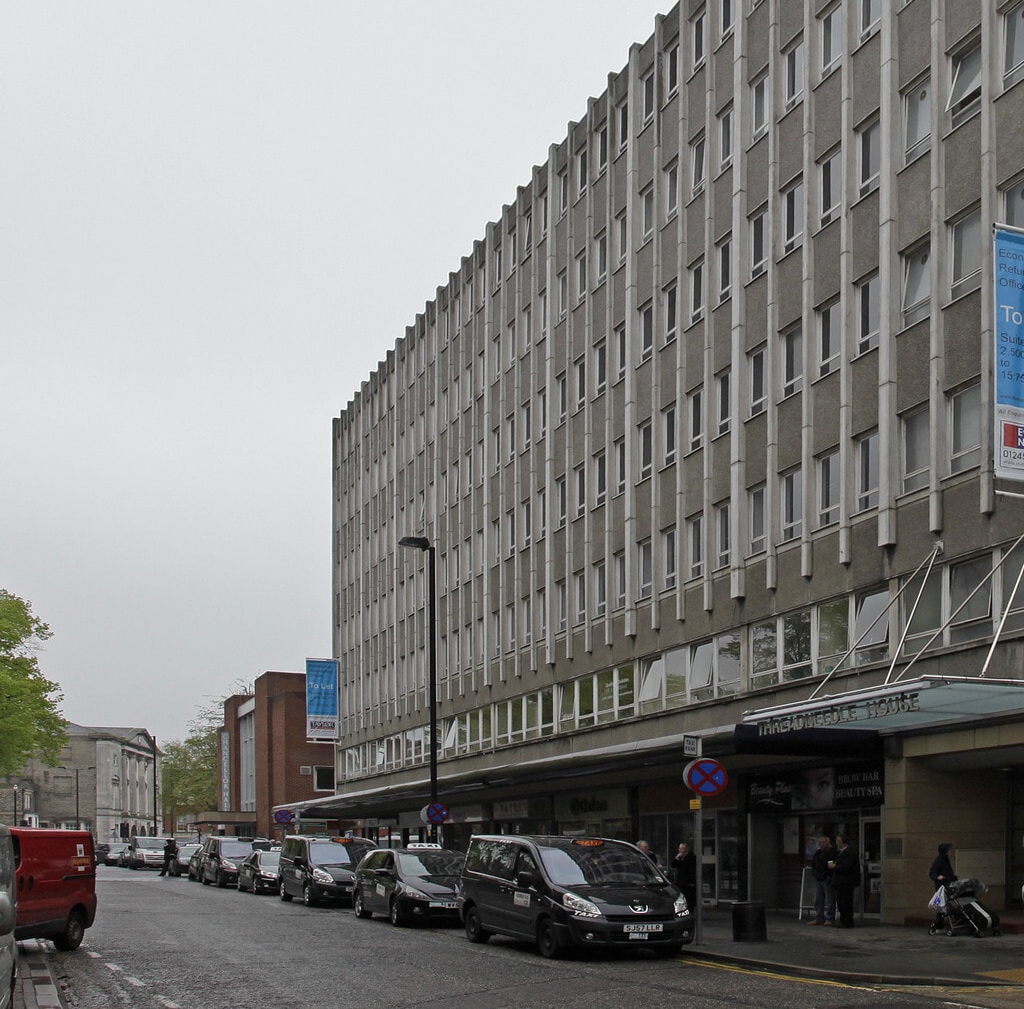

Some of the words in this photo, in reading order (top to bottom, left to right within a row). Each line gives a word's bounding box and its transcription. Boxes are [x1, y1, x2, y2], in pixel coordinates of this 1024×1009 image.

[1000, 305, 1023, 325] To
[1000, 359, 1010, 368] to
[757, 705, 857, 736] THREADNEEDLE
[867, 692, 920, 719] HOUSE
[867, 786, 883, 796] SPA
[574, 910, 599, 918] TAXI
